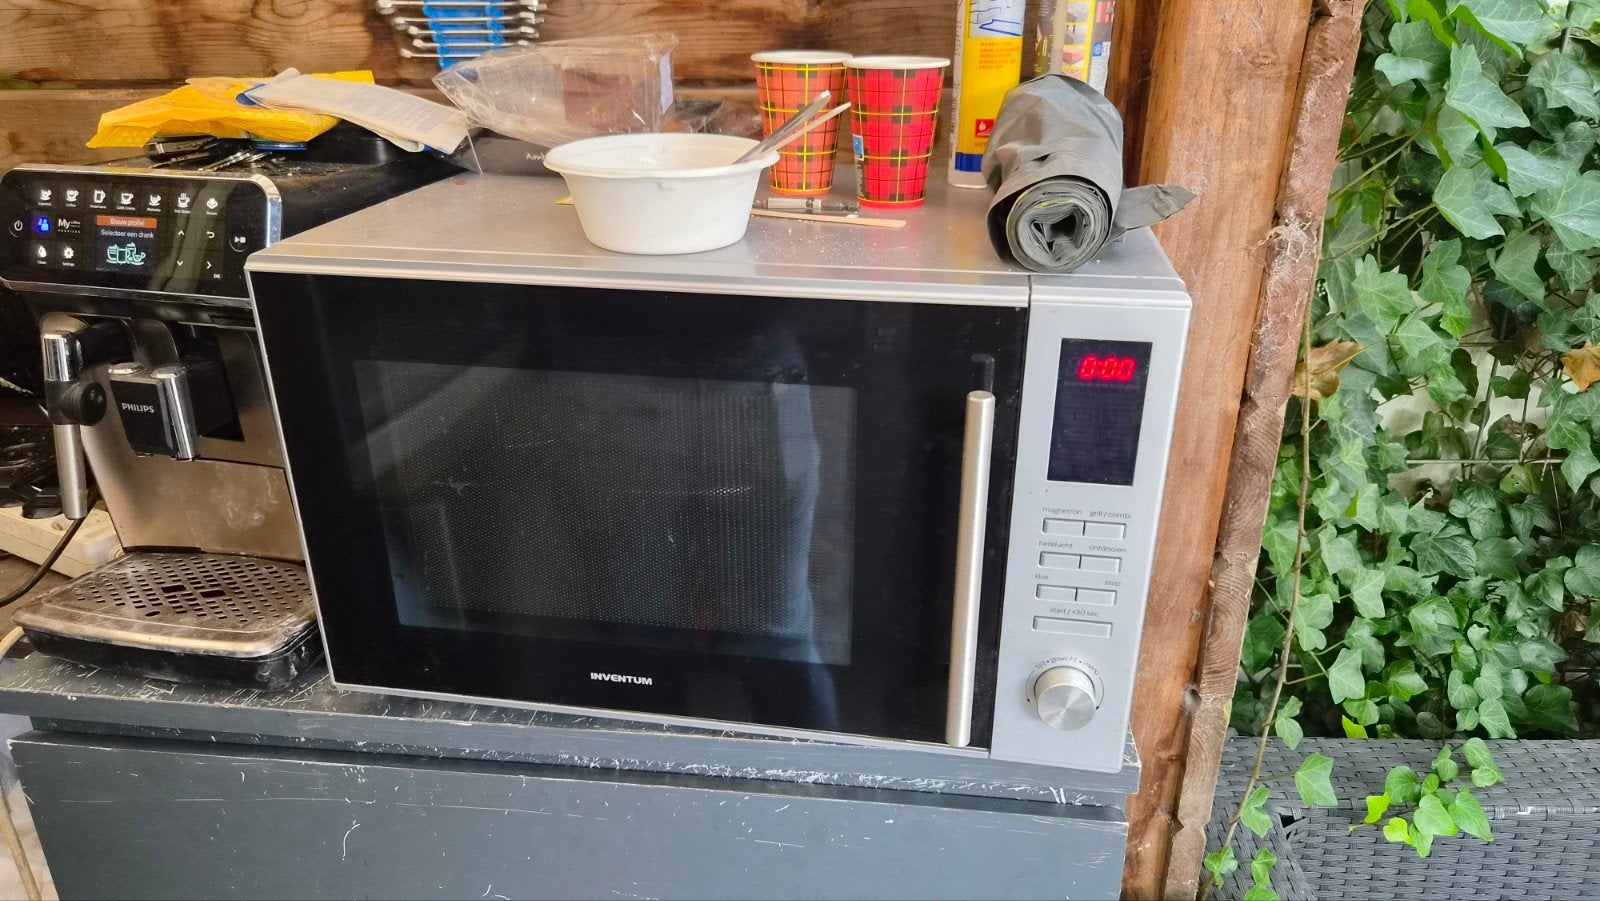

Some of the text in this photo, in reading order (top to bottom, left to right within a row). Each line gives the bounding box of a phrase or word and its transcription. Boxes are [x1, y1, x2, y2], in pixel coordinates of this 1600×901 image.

[58, 218, 70, 229] My
[127, 219, 145, 227] profiel
[101, 229, 126, 237] Selecteer
[138, 231, 154, 239] drank
[1079, 355, 1136, 381] 0:00
[121, 402, 155, 413] PHILIPS
[1042, 506, 1083, 515] magnetron
[1038, 541, 1073, 549] hetelucht
[1088, 545, 1127, 553] ontdooien
[1104, 580, 1121, 588] stop
[1049, 607, 1066, 615] start
[590, 672, 653, 686] INVENTUM
